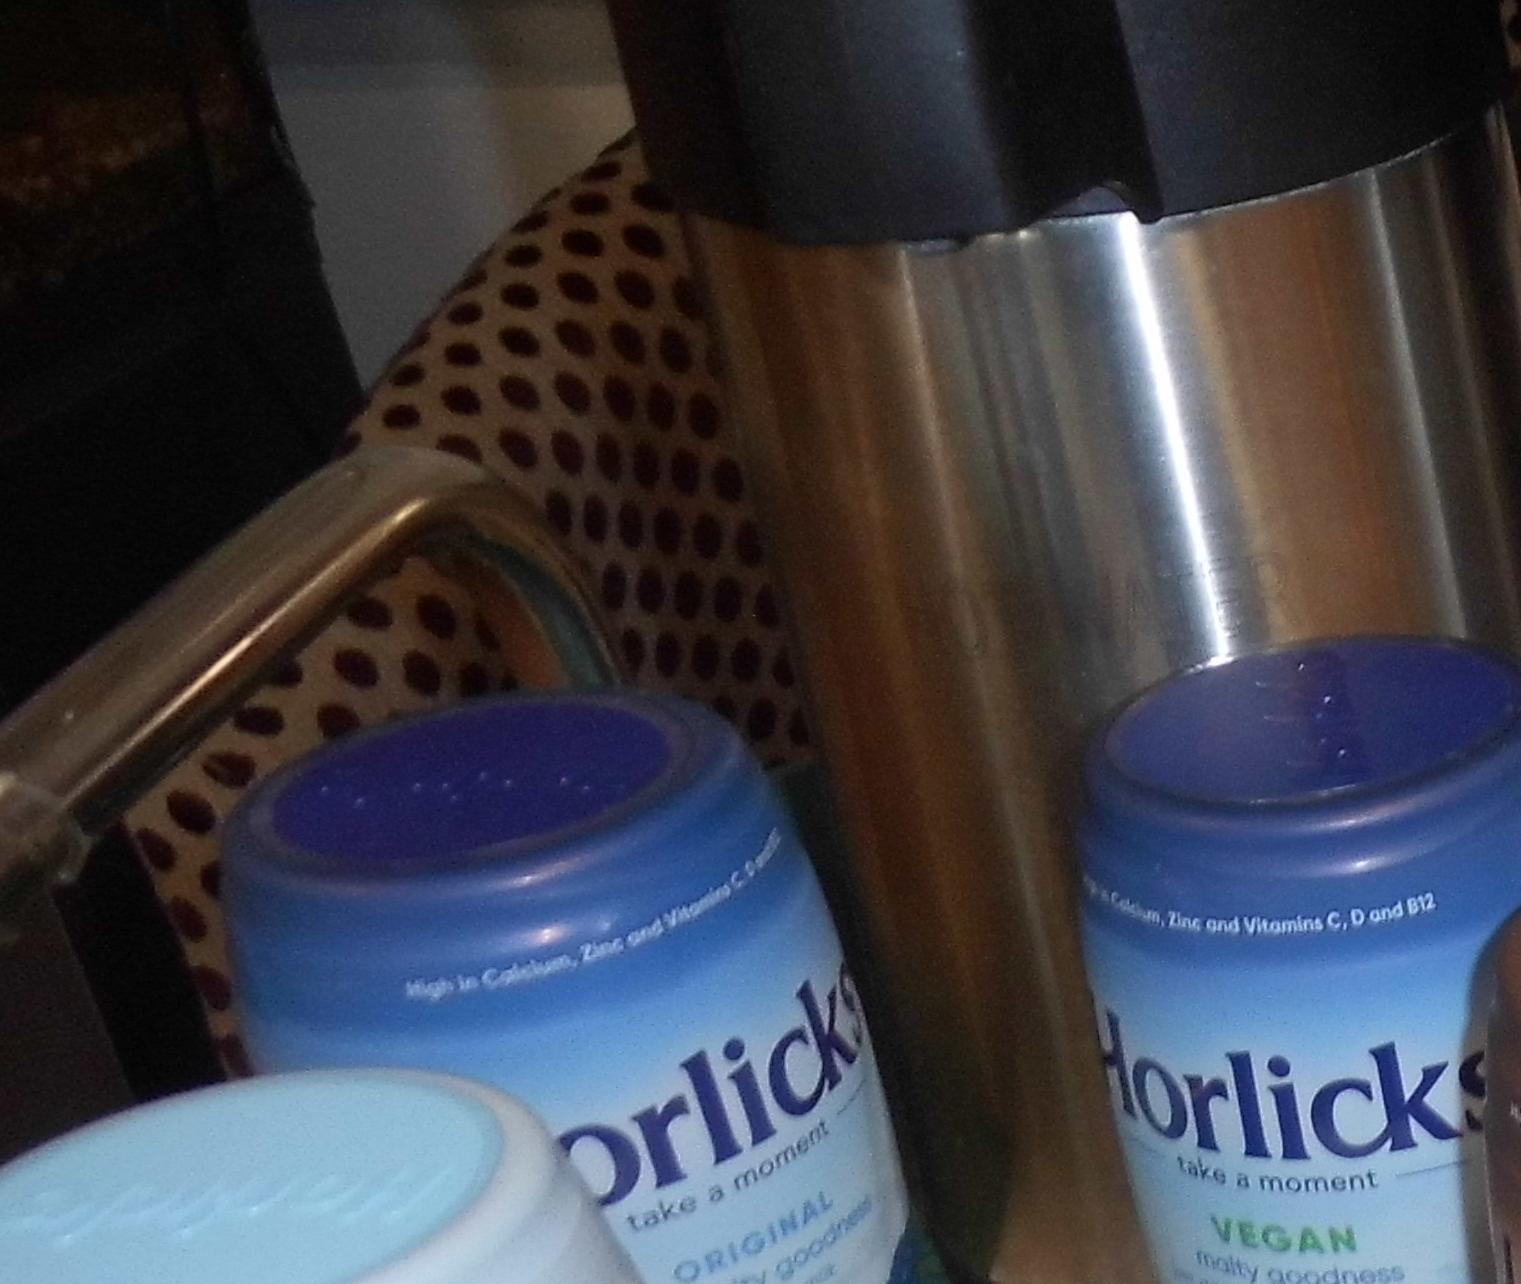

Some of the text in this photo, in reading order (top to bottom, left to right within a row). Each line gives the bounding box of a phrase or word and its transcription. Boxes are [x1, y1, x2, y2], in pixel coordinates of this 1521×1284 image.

[1168, 911, 1200, 932] Zinc
[1206, 916, 1240, 934] and
[1243, 914, 1323, 936] Vitamins
[1352, 909, 1364, 926] D
[1369, 901, 1403, 923] and
[1407, 892, 1436, 914] B12
[626, 1120, 830, 1234] take a moment
[1177, 1154, 1379, 1194] take a moment
[673, 1190, 834, 1283] ORIGINAL
[1210, 1215, 1358, 1254] VEGAN
[1196, 1248, 1260, 1284] malty
